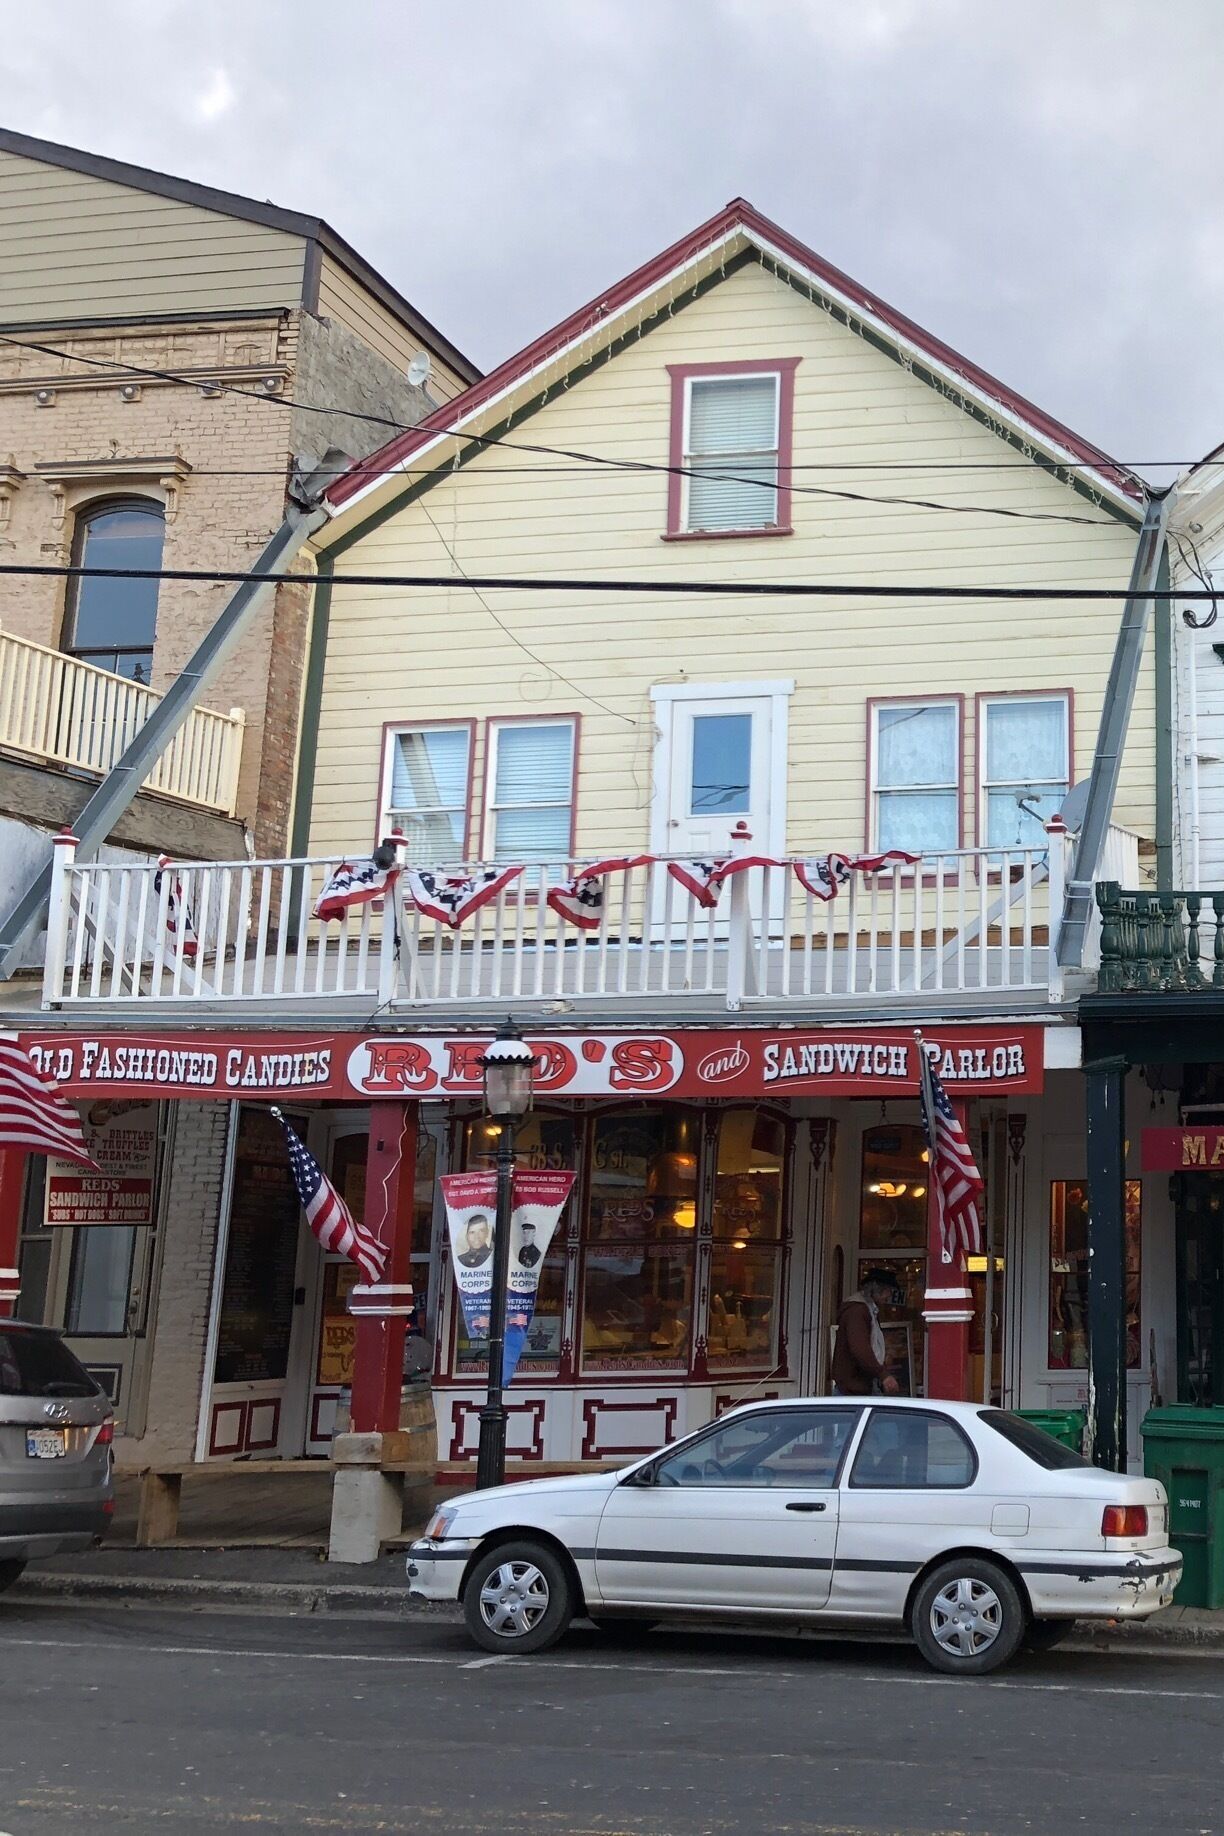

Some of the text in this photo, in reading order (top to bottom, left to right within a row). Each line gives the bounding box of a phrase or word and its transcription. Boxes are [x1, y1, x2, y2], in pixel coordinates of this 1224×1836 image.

[80, 1042, 217, 1085] FASHIONED
[225, 1049, 331, 1087] CANDIES
[703, 1040, 744, 1079] and
[763, 1043, 908, 1081] SANDWICH
[50, 1192, 151, 1207] SANDWICH PARLOR
[460, 1270, 493, 1279] MARINE
[461, 1280, 490, 1288] CORPS
